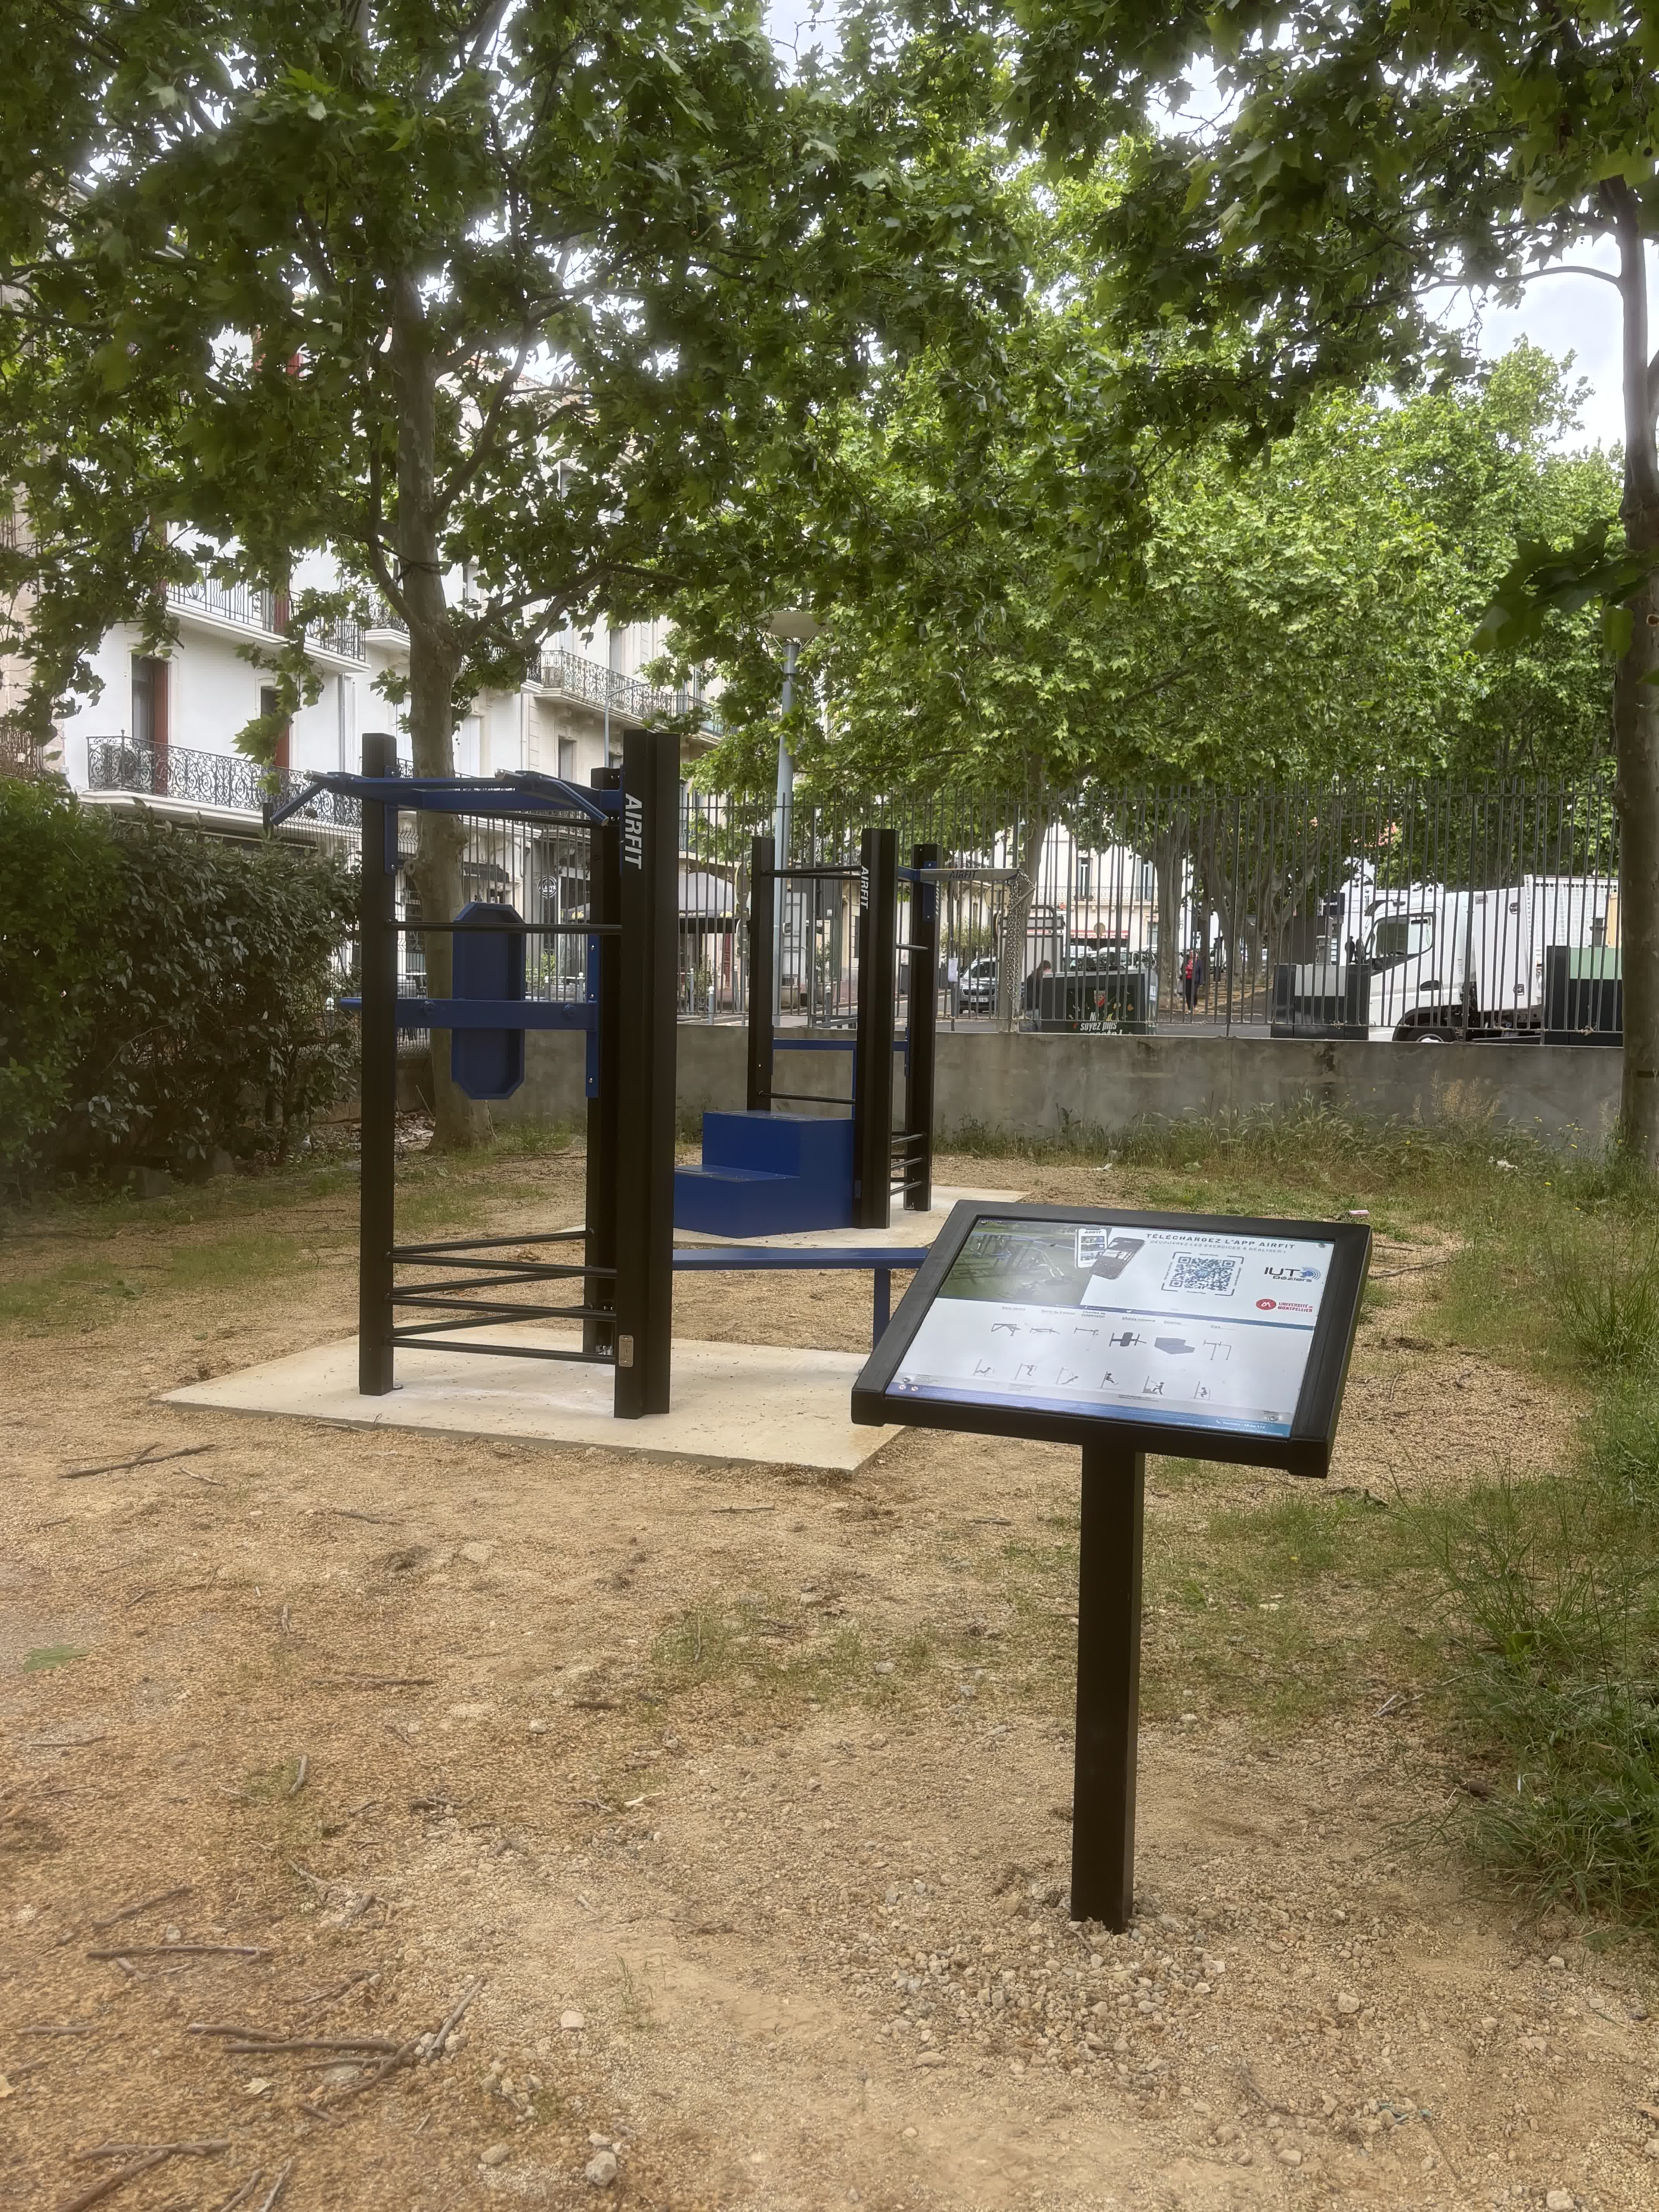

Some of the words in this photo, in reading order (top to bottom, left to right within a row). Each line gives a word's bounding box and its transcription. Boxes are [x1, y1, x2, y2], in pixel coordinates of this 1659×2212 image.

[625, 793, 642, 870] AIRFIT
[949, 870, 977, 879] AIRFIT
[861, 865, 869, 910] AIRFIT
[1080, 1022, 1101, 1032] soyez
[1102, 1022, 1118, 1031] plus
[1146, 1233, 1221, 1243] TÉLÉCHARGEZ
[1264, 1267, 1301, 1277] IUT
